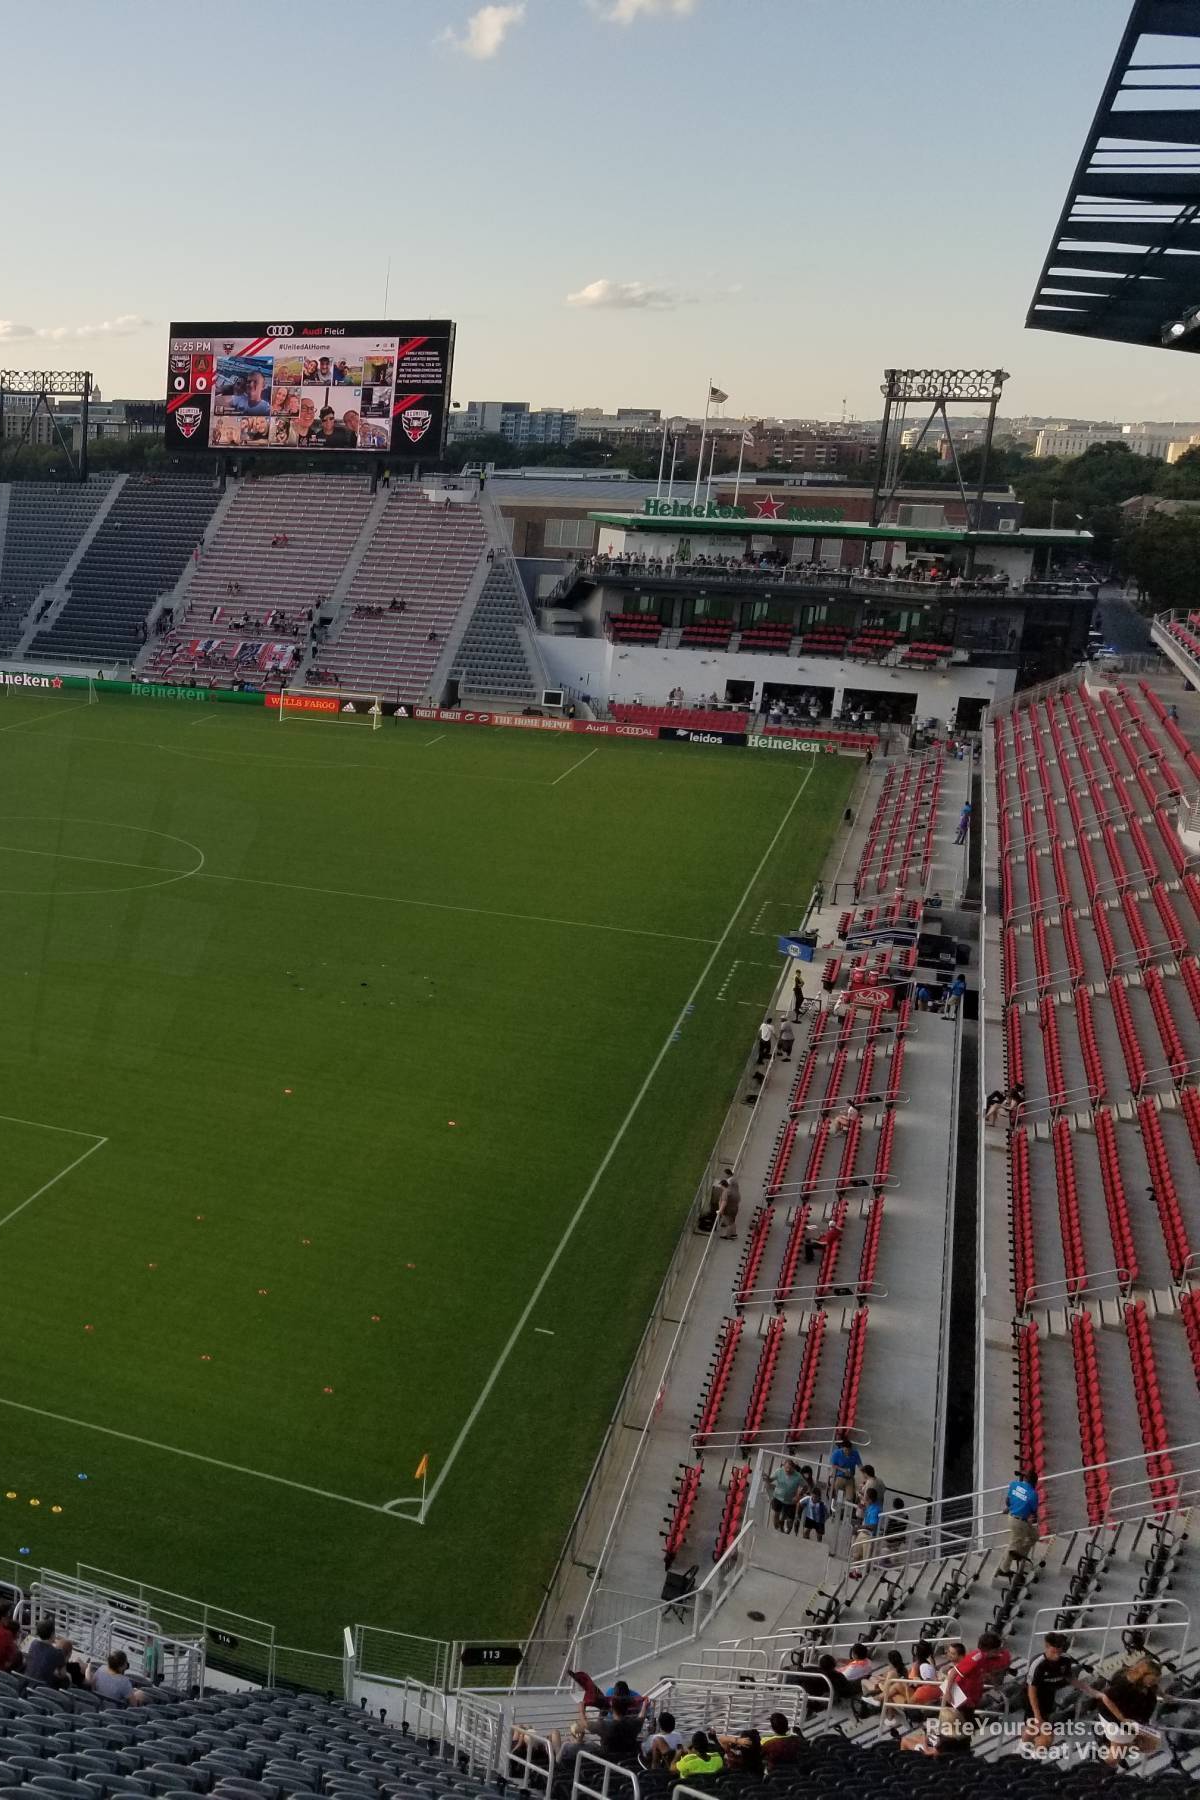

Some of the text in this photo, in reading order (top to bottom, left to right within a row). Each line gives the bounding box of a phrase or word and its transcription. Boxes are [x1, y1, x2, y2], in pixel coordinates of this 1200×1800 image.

[173, 341, 211, 351] 6:25 PM
[279, 343, 331, 351] #UnitedAtHome
[174, 376, 185, 390] 0
[196, 377, 207, 390] 0
[644, 499, 747, 520] Heineken
[131, 683, 206, 702] Heineken
[303, 700, 336, 710] FARGO
[494, 715, 572, 730] THE HOME DEPOT
[585, 723, 609, 733] Audi
[689, 731, 723, 744] leidos
[746, 735, 820, 753] Heineken
[483, 1650, 500, 1659] 113
